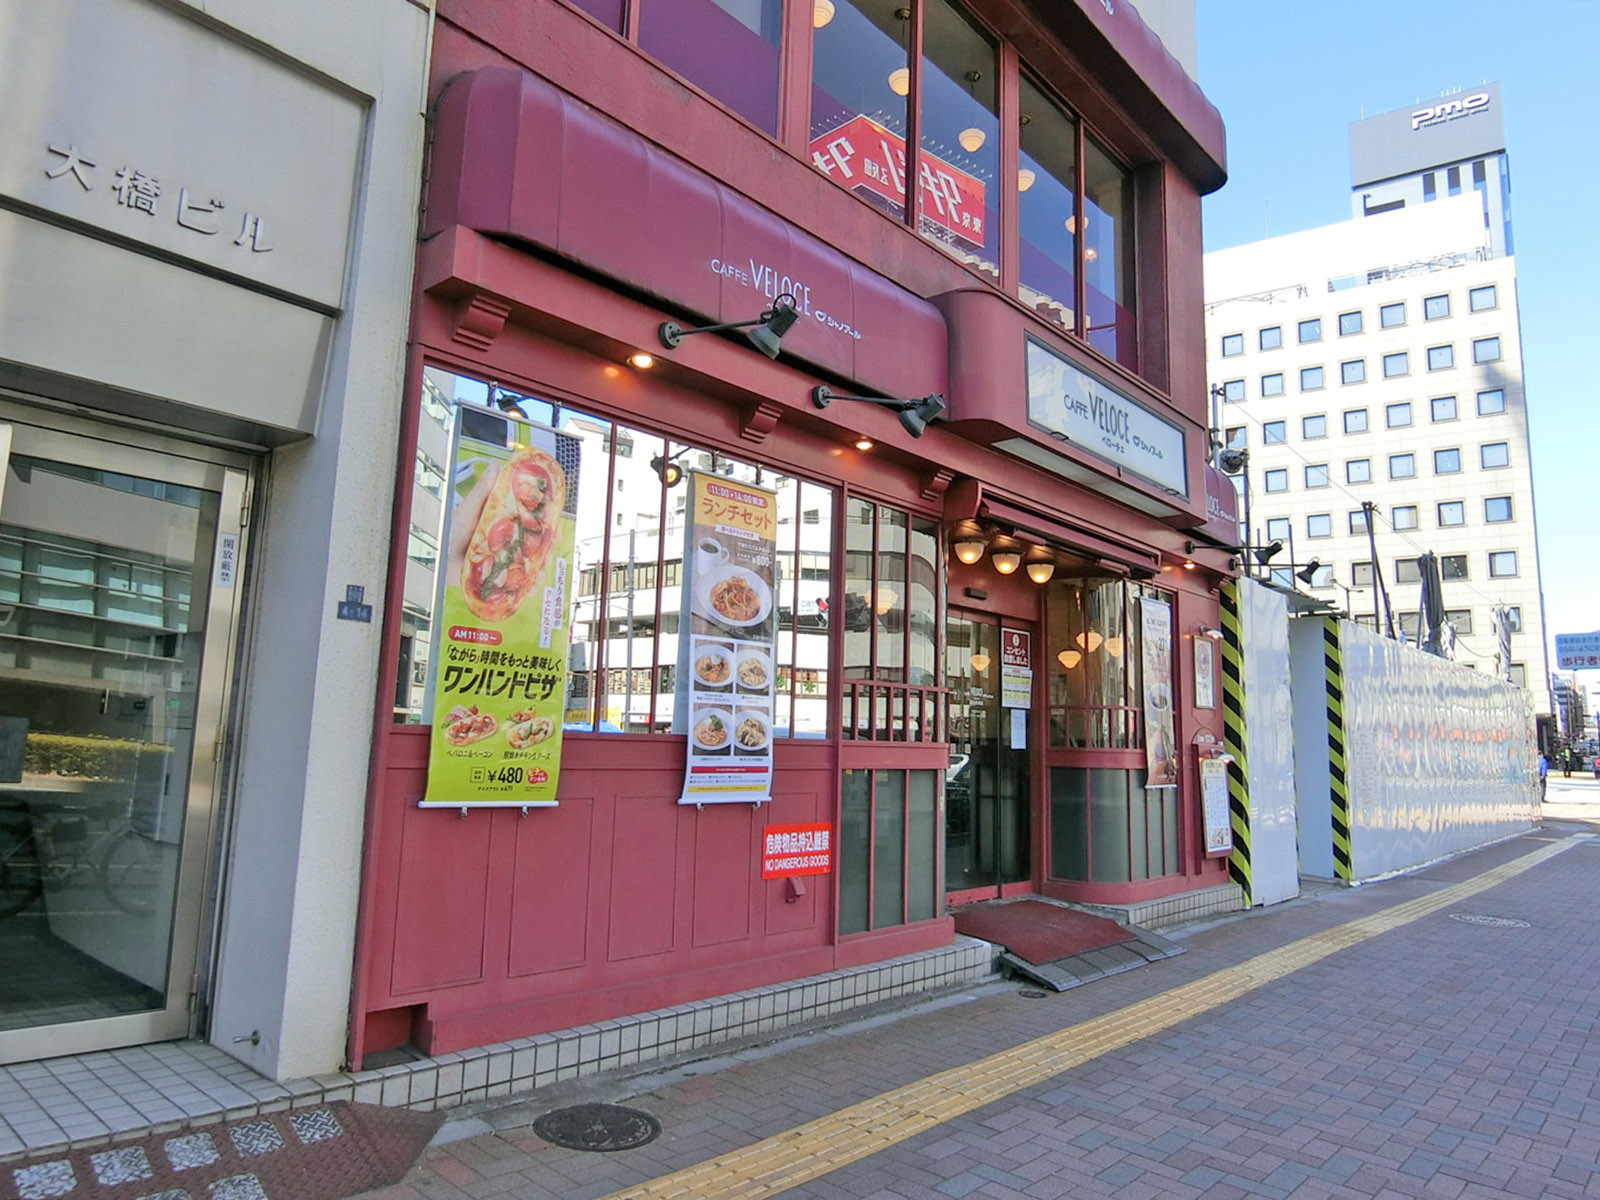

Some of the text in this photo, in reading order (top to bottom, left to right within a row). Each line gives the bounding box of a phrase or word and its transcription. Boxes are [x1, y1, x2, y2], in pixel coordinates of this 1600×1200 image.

[45, 144, 273, 253] 大橋ビル
[711, 258, 748, 287] CAFFE
[749, 258, 811, 317] VELOCE
[1063, 394, 1089, 420] CAFFE
[1088, 391, 1130, 444] VELOCE
[702, 496, 772, 530] ランチセット
[444, 665, 562, 701] ワンハンドピザ
[487, 766, 523, 784] ¥480
[765, 854, 830, 872] NO DANGEROUS GOODS
